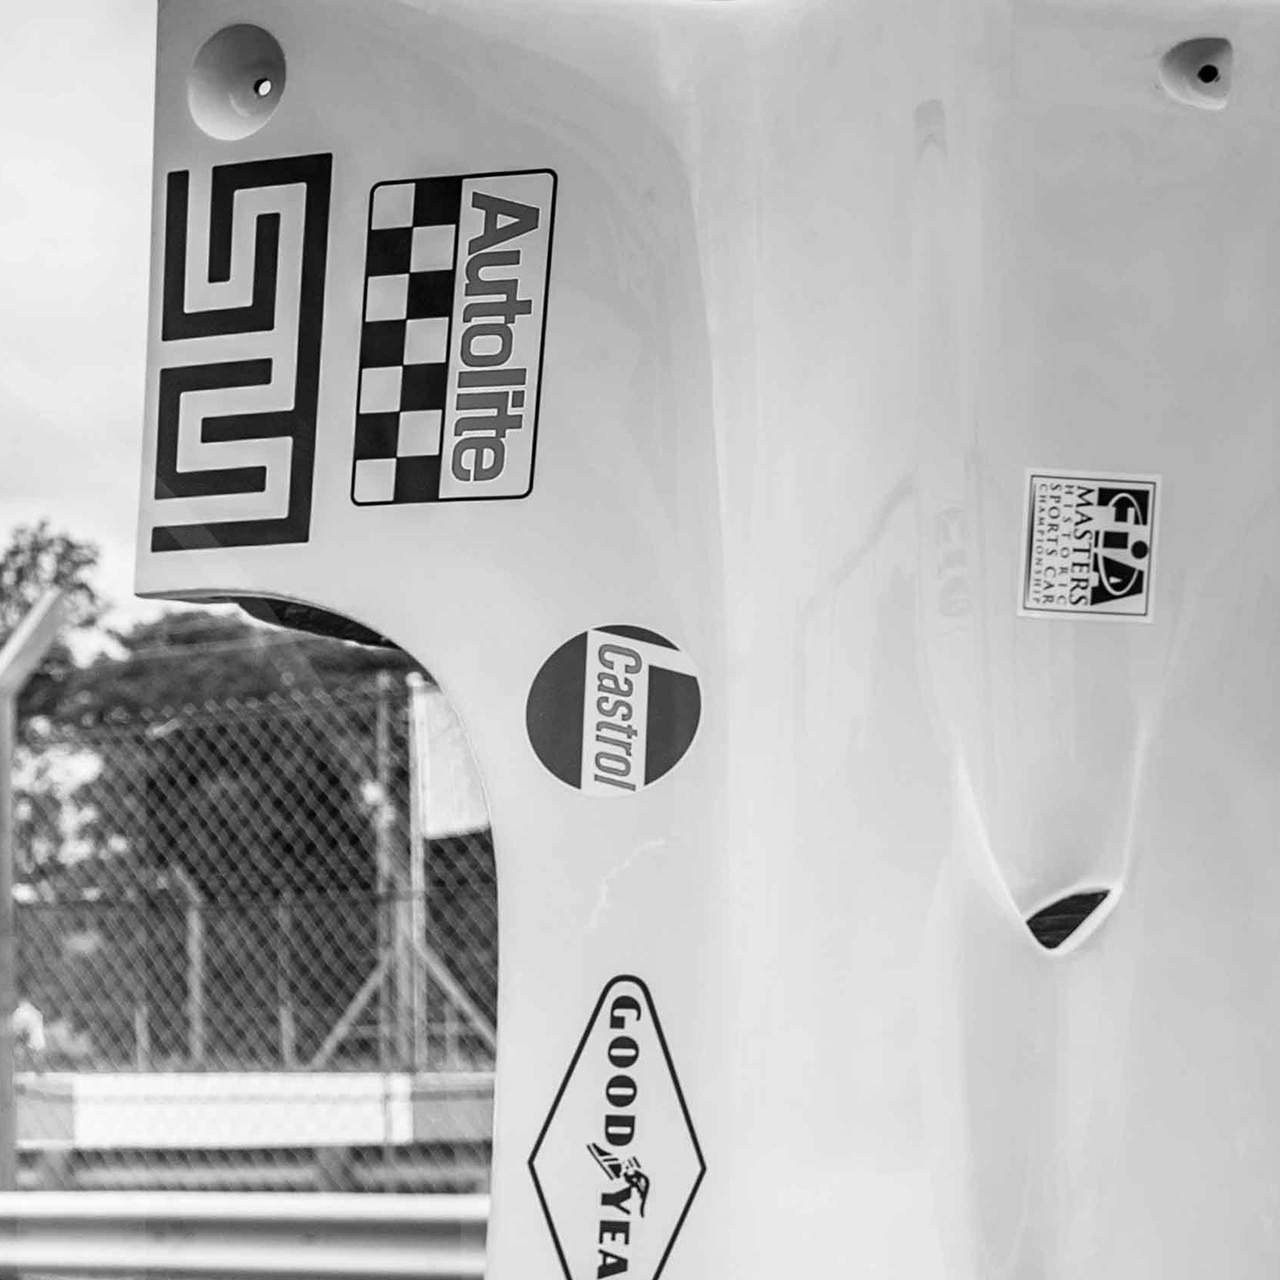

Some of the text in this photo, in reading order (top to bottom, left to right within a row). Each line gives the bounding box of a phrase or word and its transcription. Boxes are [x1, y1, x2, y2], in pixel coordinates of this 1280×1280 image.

[451, 190, 540, 483] Autolite
[1032, 483, 1049, 604] CHAMPIONSHIP
[1042, 482, 1062, 604] SPORTS CAR
[1056, 484, 1075, 606] HISTORIC
[1069, 486, 1095, 607] MASTERS
[594, 643, 643, 792] Castrol
